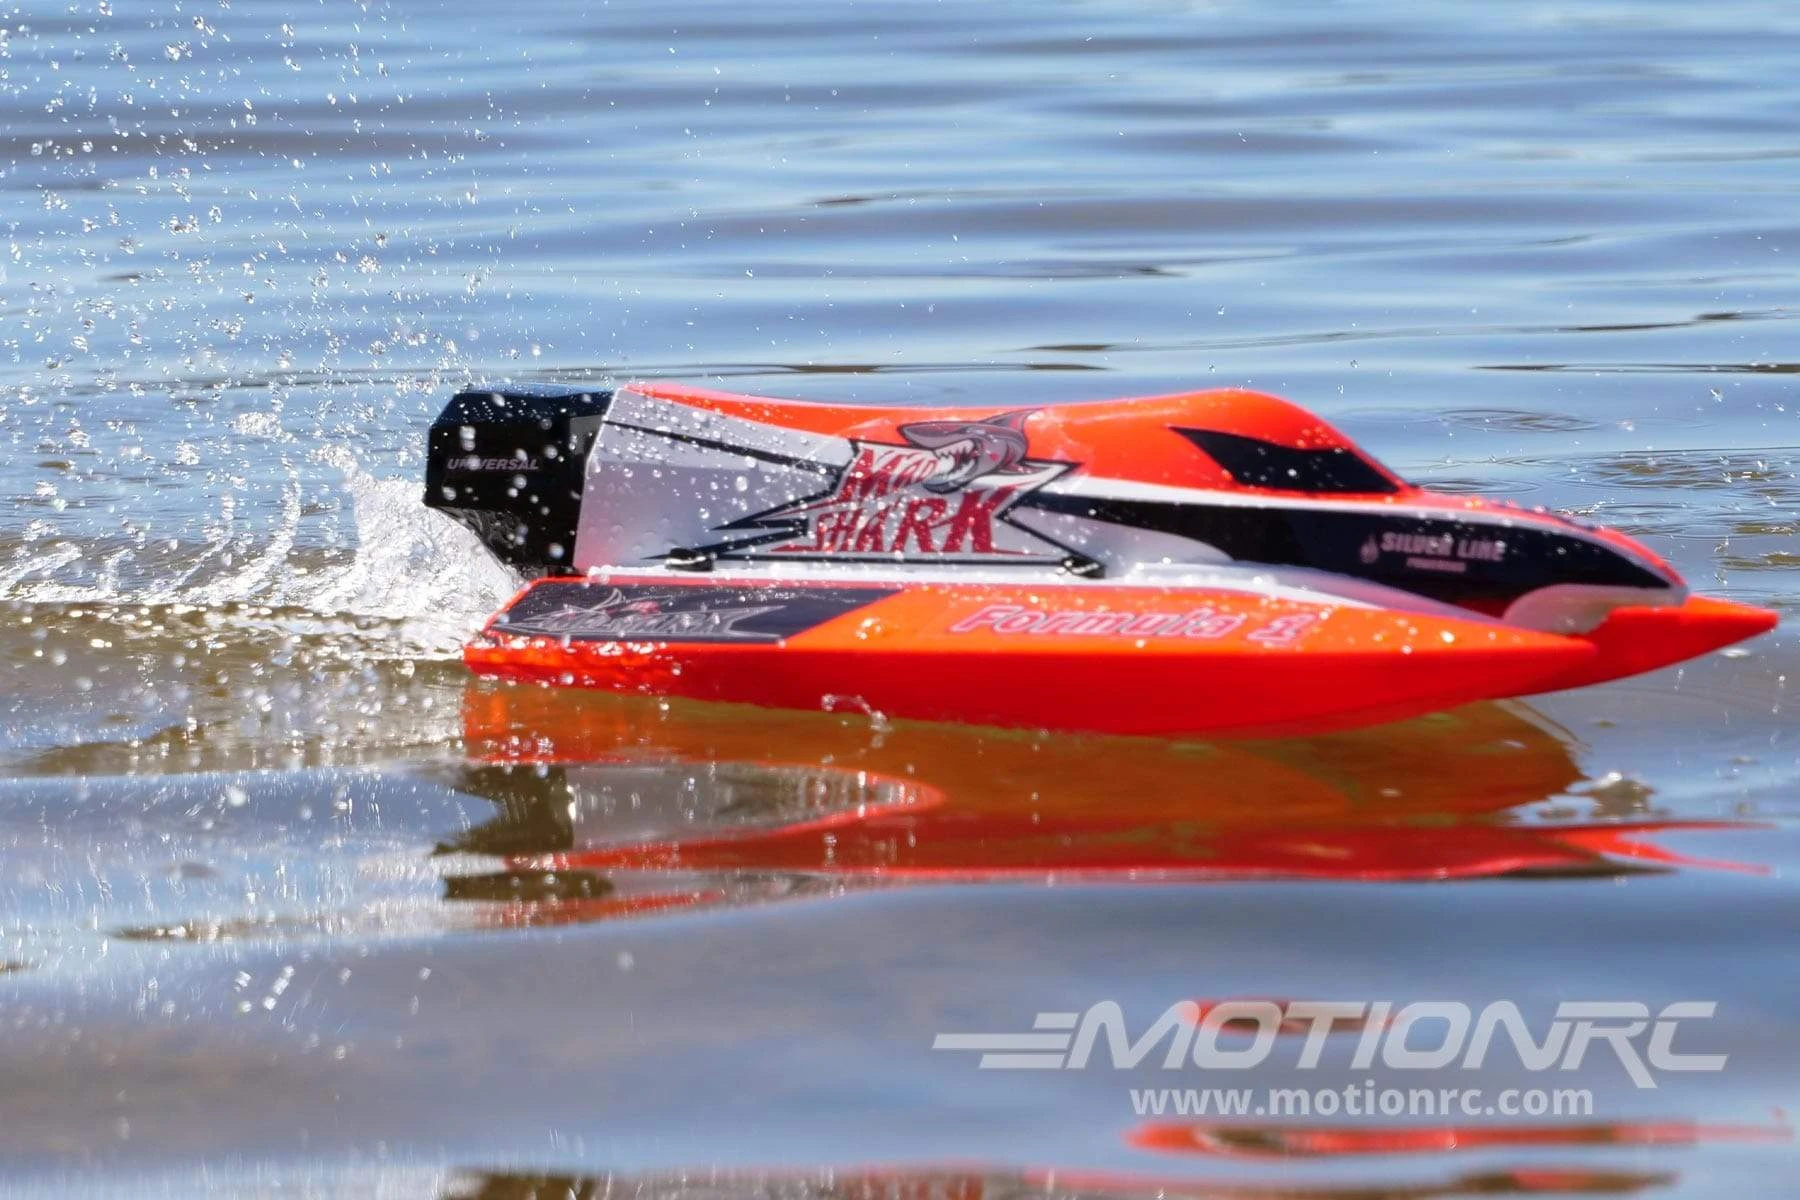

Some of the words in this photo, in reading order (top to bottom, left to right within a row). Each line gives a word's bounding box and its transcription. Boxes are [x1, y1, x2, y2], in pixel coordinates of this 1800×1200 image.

[448, 457, 538, 470] UNVERSAL
[800, 485, 1018, 554] SHARK
[952, 604, 1244, 638] Formula
